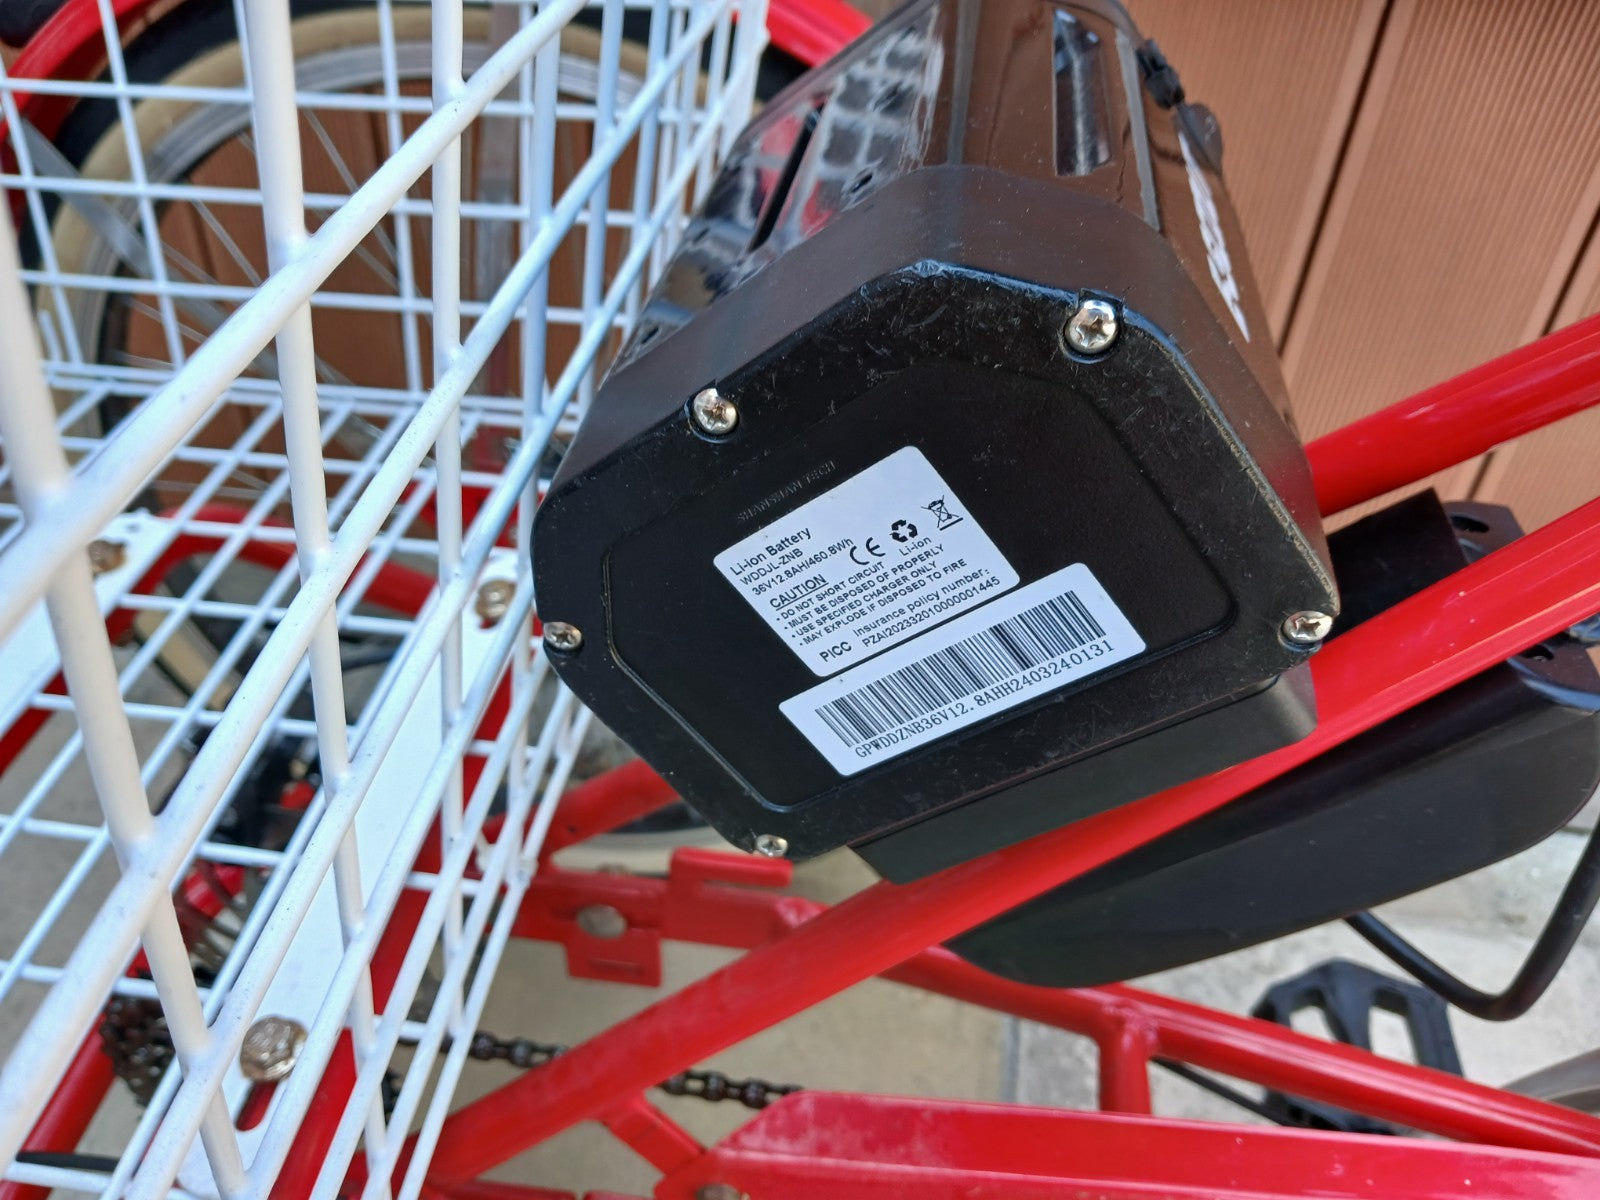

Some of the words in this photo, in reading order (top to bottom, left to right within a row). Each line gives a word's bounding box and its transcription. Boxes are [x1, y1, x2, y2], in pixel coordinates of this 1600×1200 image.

[730, 554, 767, 575] Li-ion
[765, 528, 811, 556] Battery
[740, 548, 803, 585] WDDJL-ZNB
[752, 539, 853, 595] 36V12.8AH/460.8Wh
[850, 537, 885, 565] CE
[899, 538, 931, 556] Li-ion
[770, 574, 827, 610] CAUTION
[781, 609, 795, 619] DO
[792, 598, 814, 613] NOT
[816, 581, 846, 601] SHORT
[848, 562, 884, 584] CIRCUIT
[788, 611, 813, 628] MUST
[814, 604, 828, 614] BE
[828, 580, 875, 607] DISPOSED
[876, 572, 889, 582] OF
[891, 544, 943, 575] PROPERLY
[796, 623, 815, 635] USE
[816, 600, 862, 626] SPECIFIED
[863, 576, 910, 602] CHARGER
[911, 561, 936, 578] ONLY
[803, 630, 822, 644] MAY
[824, 609, 867, 633] EXPLODE
[867, 603, 875, 612] IF
[877, 580, 926, 606] DISPOSED
[926, 572, 941, 581] TO
[943, 559, 967, 574] FIRE
[853, 609, 906, 636] Insurance
[907, 591, 940, 613] policy
[941, 569, 989, 594] number:
[819, 642, 851, 662] PICC
